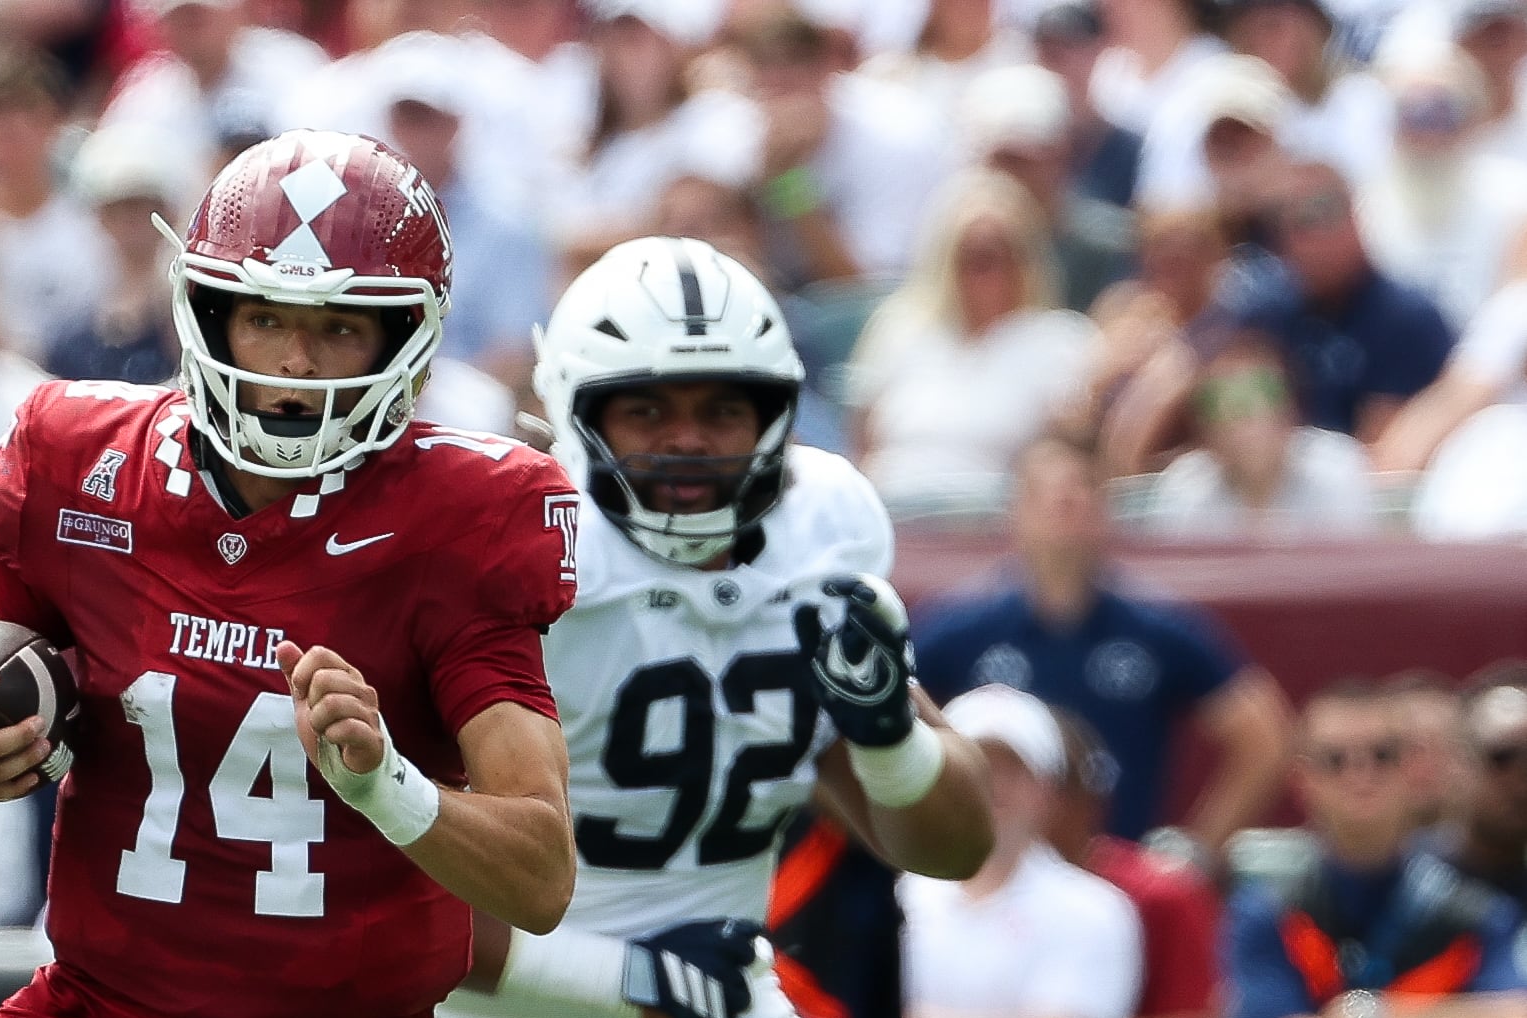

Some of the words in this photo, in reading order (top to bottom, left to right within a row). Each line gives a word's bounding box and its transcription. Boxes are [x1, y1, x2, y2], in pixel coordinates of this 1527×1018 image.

[74, 517, 128, 539] GRUNGO
[169, 612, 284, 669] TEMPLE
[116, 671, 324, 917] 14
[575, 651, 817, 870] 92
